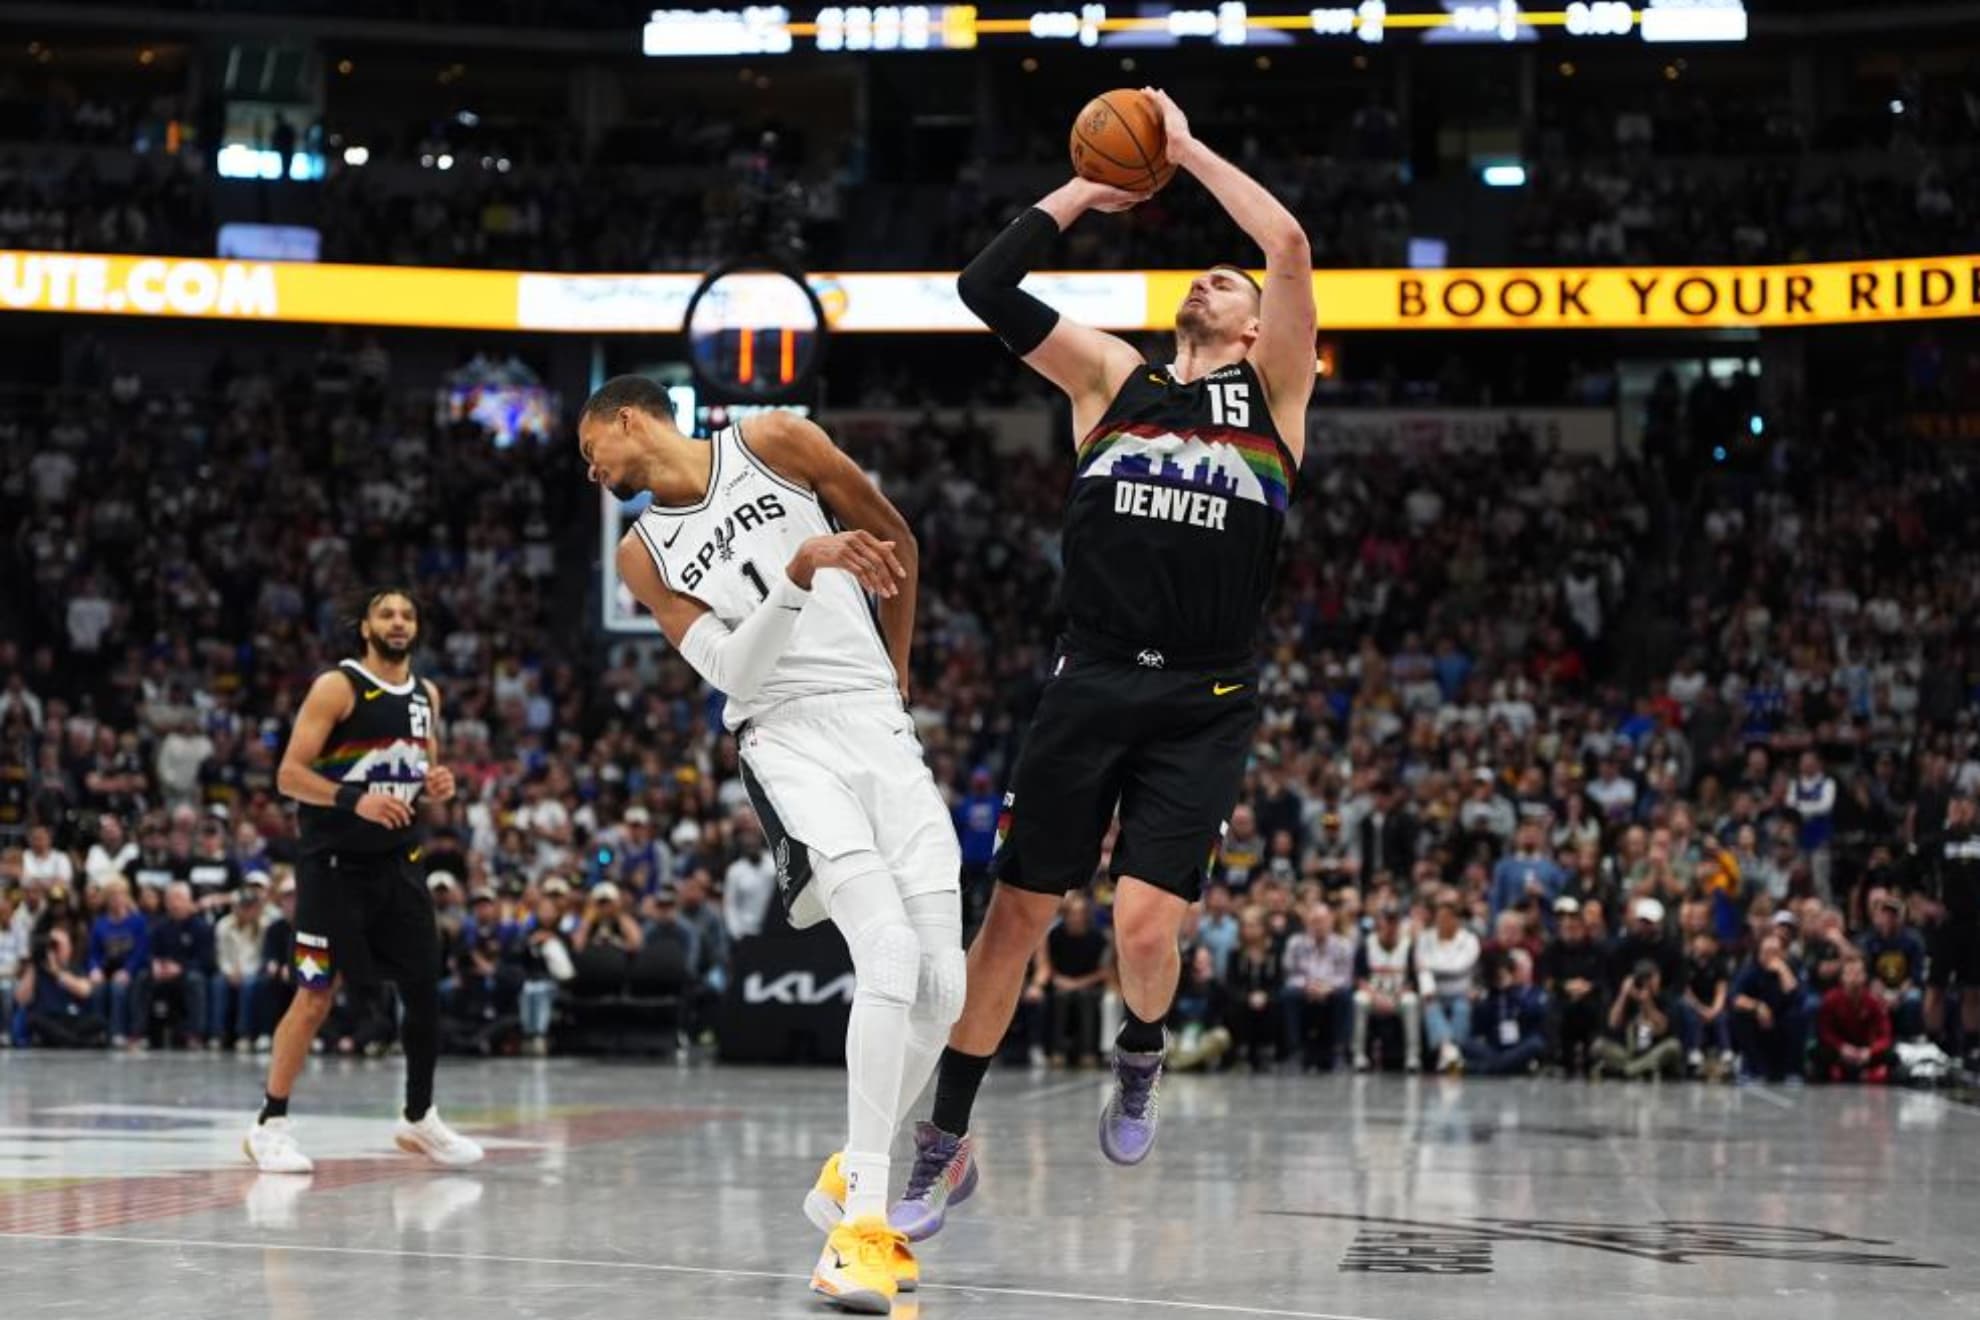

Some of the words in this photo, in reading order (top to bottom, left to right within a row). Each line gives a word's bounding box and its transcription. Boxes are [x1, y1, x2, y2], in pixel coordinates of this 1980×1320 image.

[1399, 277, 1591, 317] BOOK
[1629, 275, 1814, 316] YOUR
[1207, 383, 1249, 427] 15
[1115, 481, 1228, 530] DENVER
[680, 493, 786, 591] SPURS
[741, 561, 770, 603] 1
[744, 970, 856, 1003] KIA
